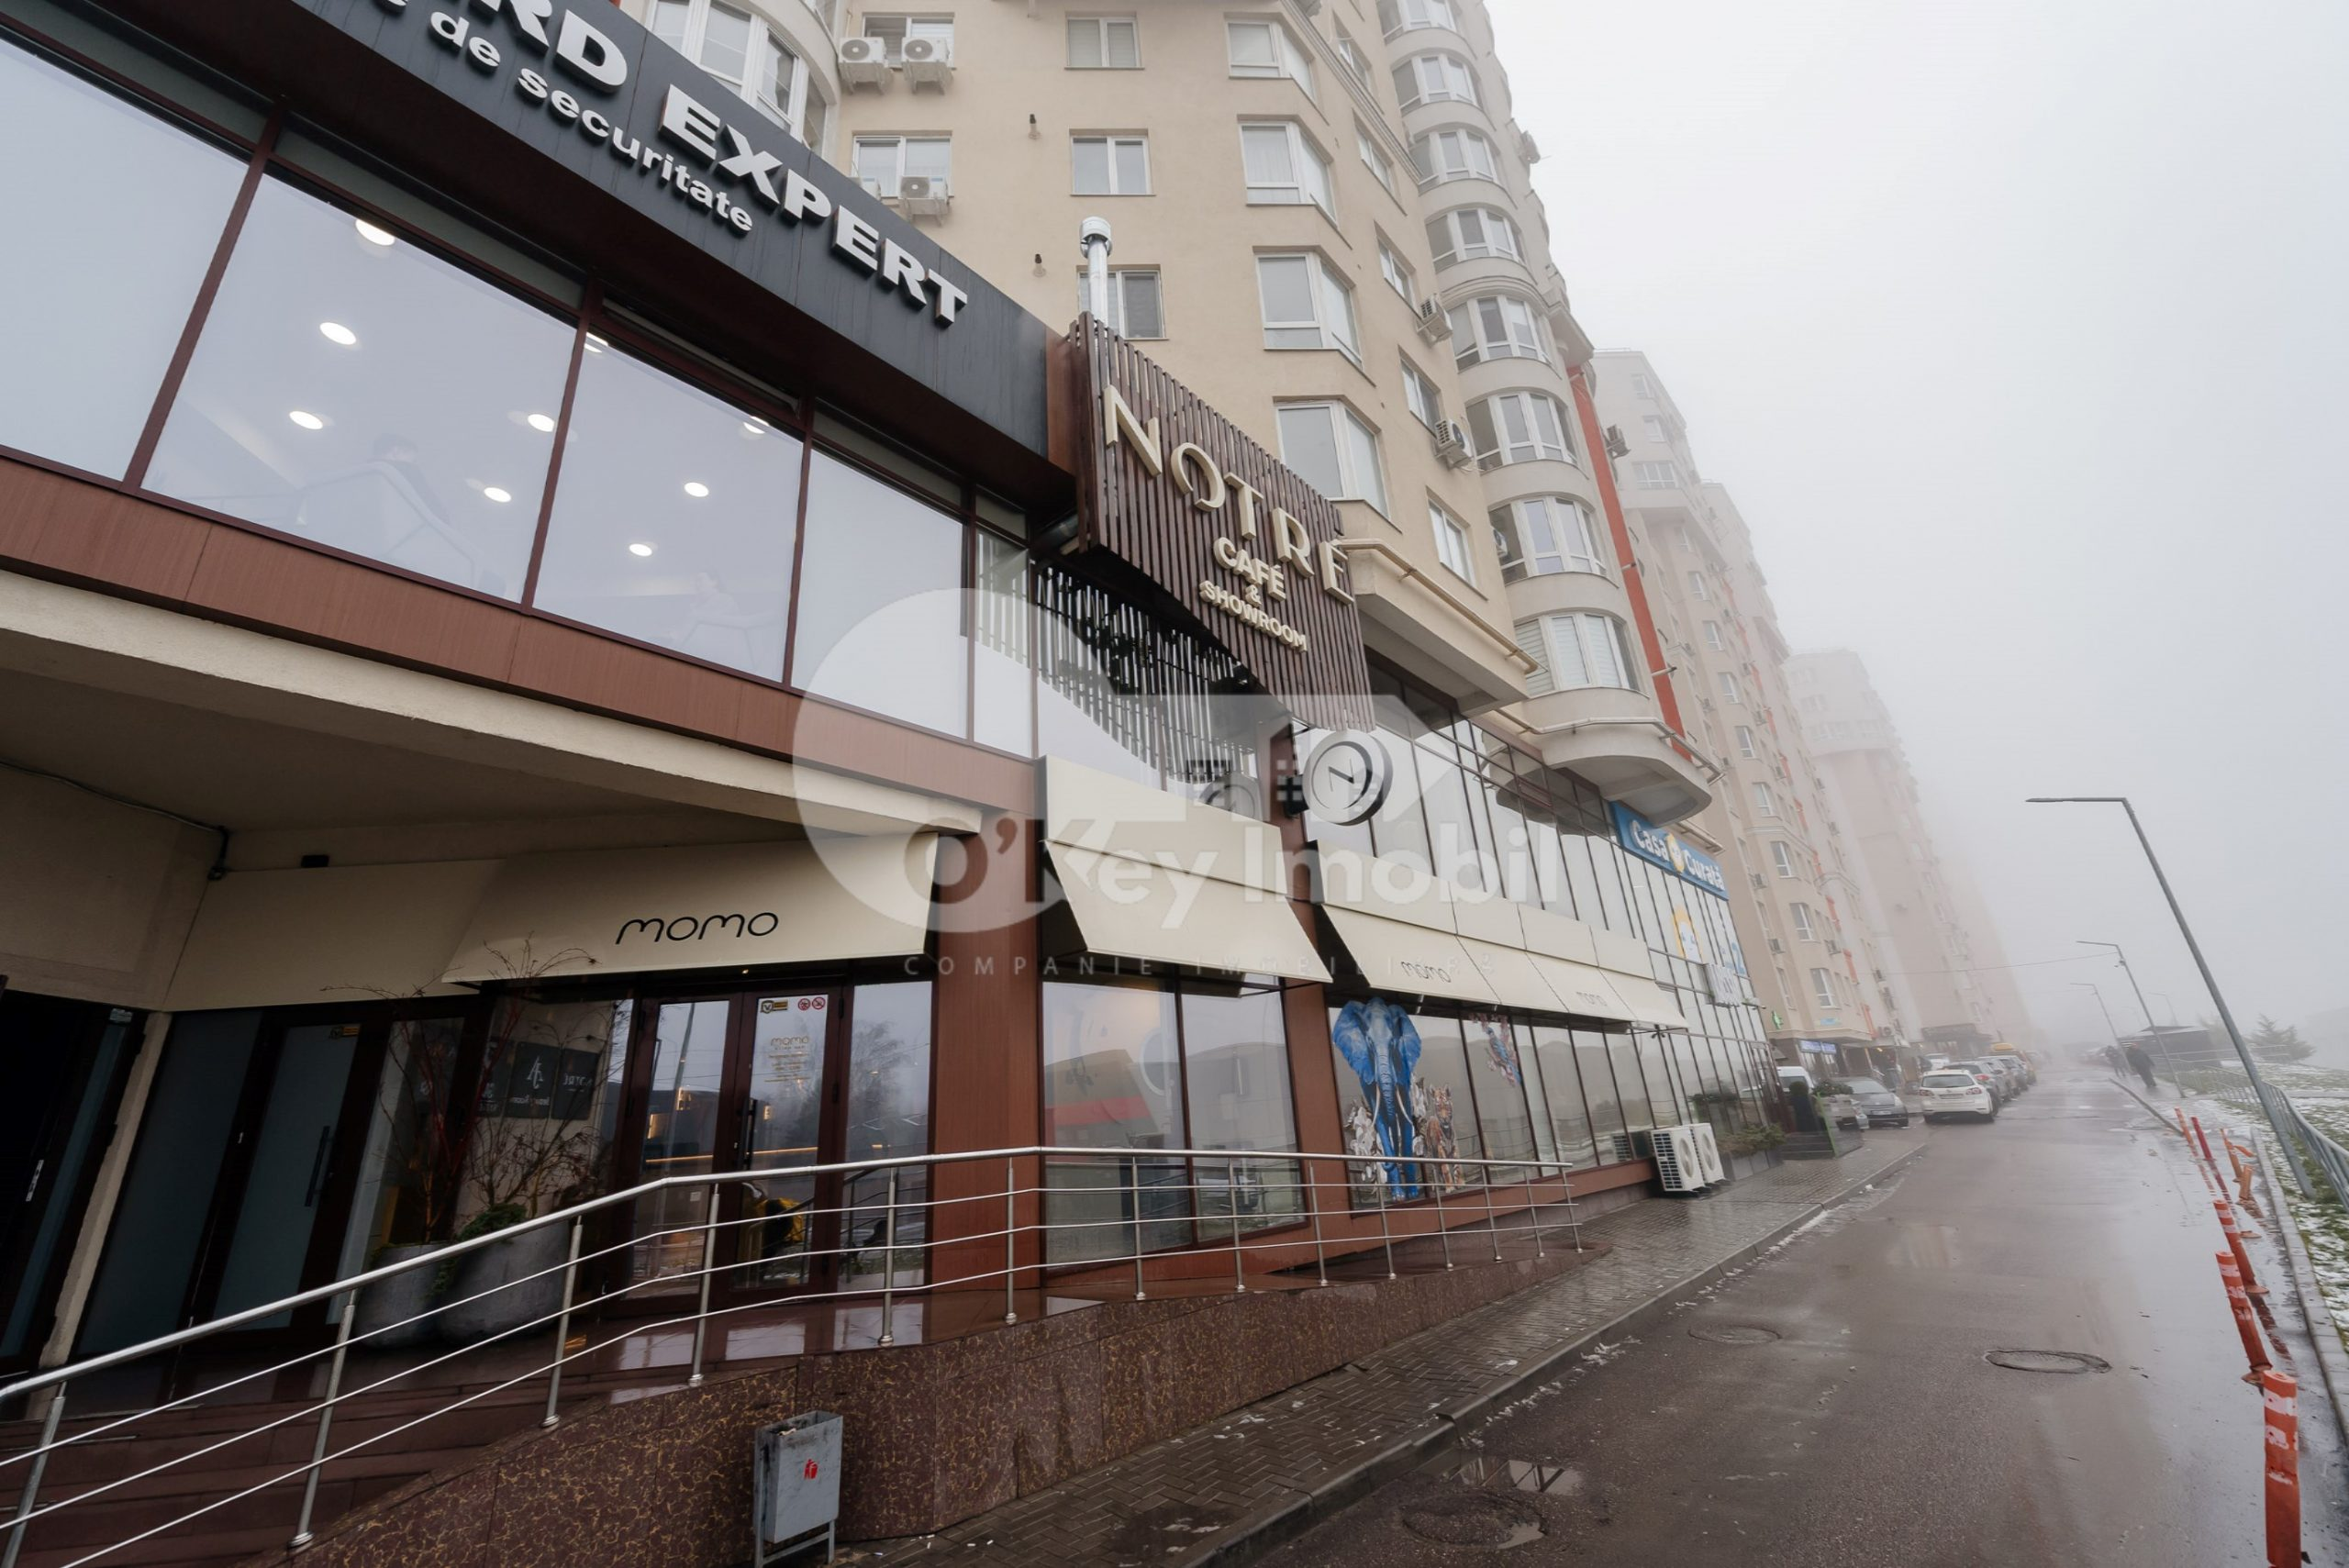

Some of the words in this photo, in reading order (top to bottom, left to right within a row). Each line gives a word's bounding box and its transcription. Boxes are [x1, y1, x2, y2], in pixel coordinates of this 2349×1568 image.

[429, 10, 501, 72] de
[516, 67, 753, 234] securitate
[658, 83, 968, 328] EXPERT
[1213, 537, 1286, 602] CAFÉ
[1244, 584, 1263, 608] &
[1198, 580, 1308, 652] SHOWROOM
[1630, 819, 1670, 862] Casa
[615, 912, 779, 945] momo
[1400, 961, 1452, 984] momo
